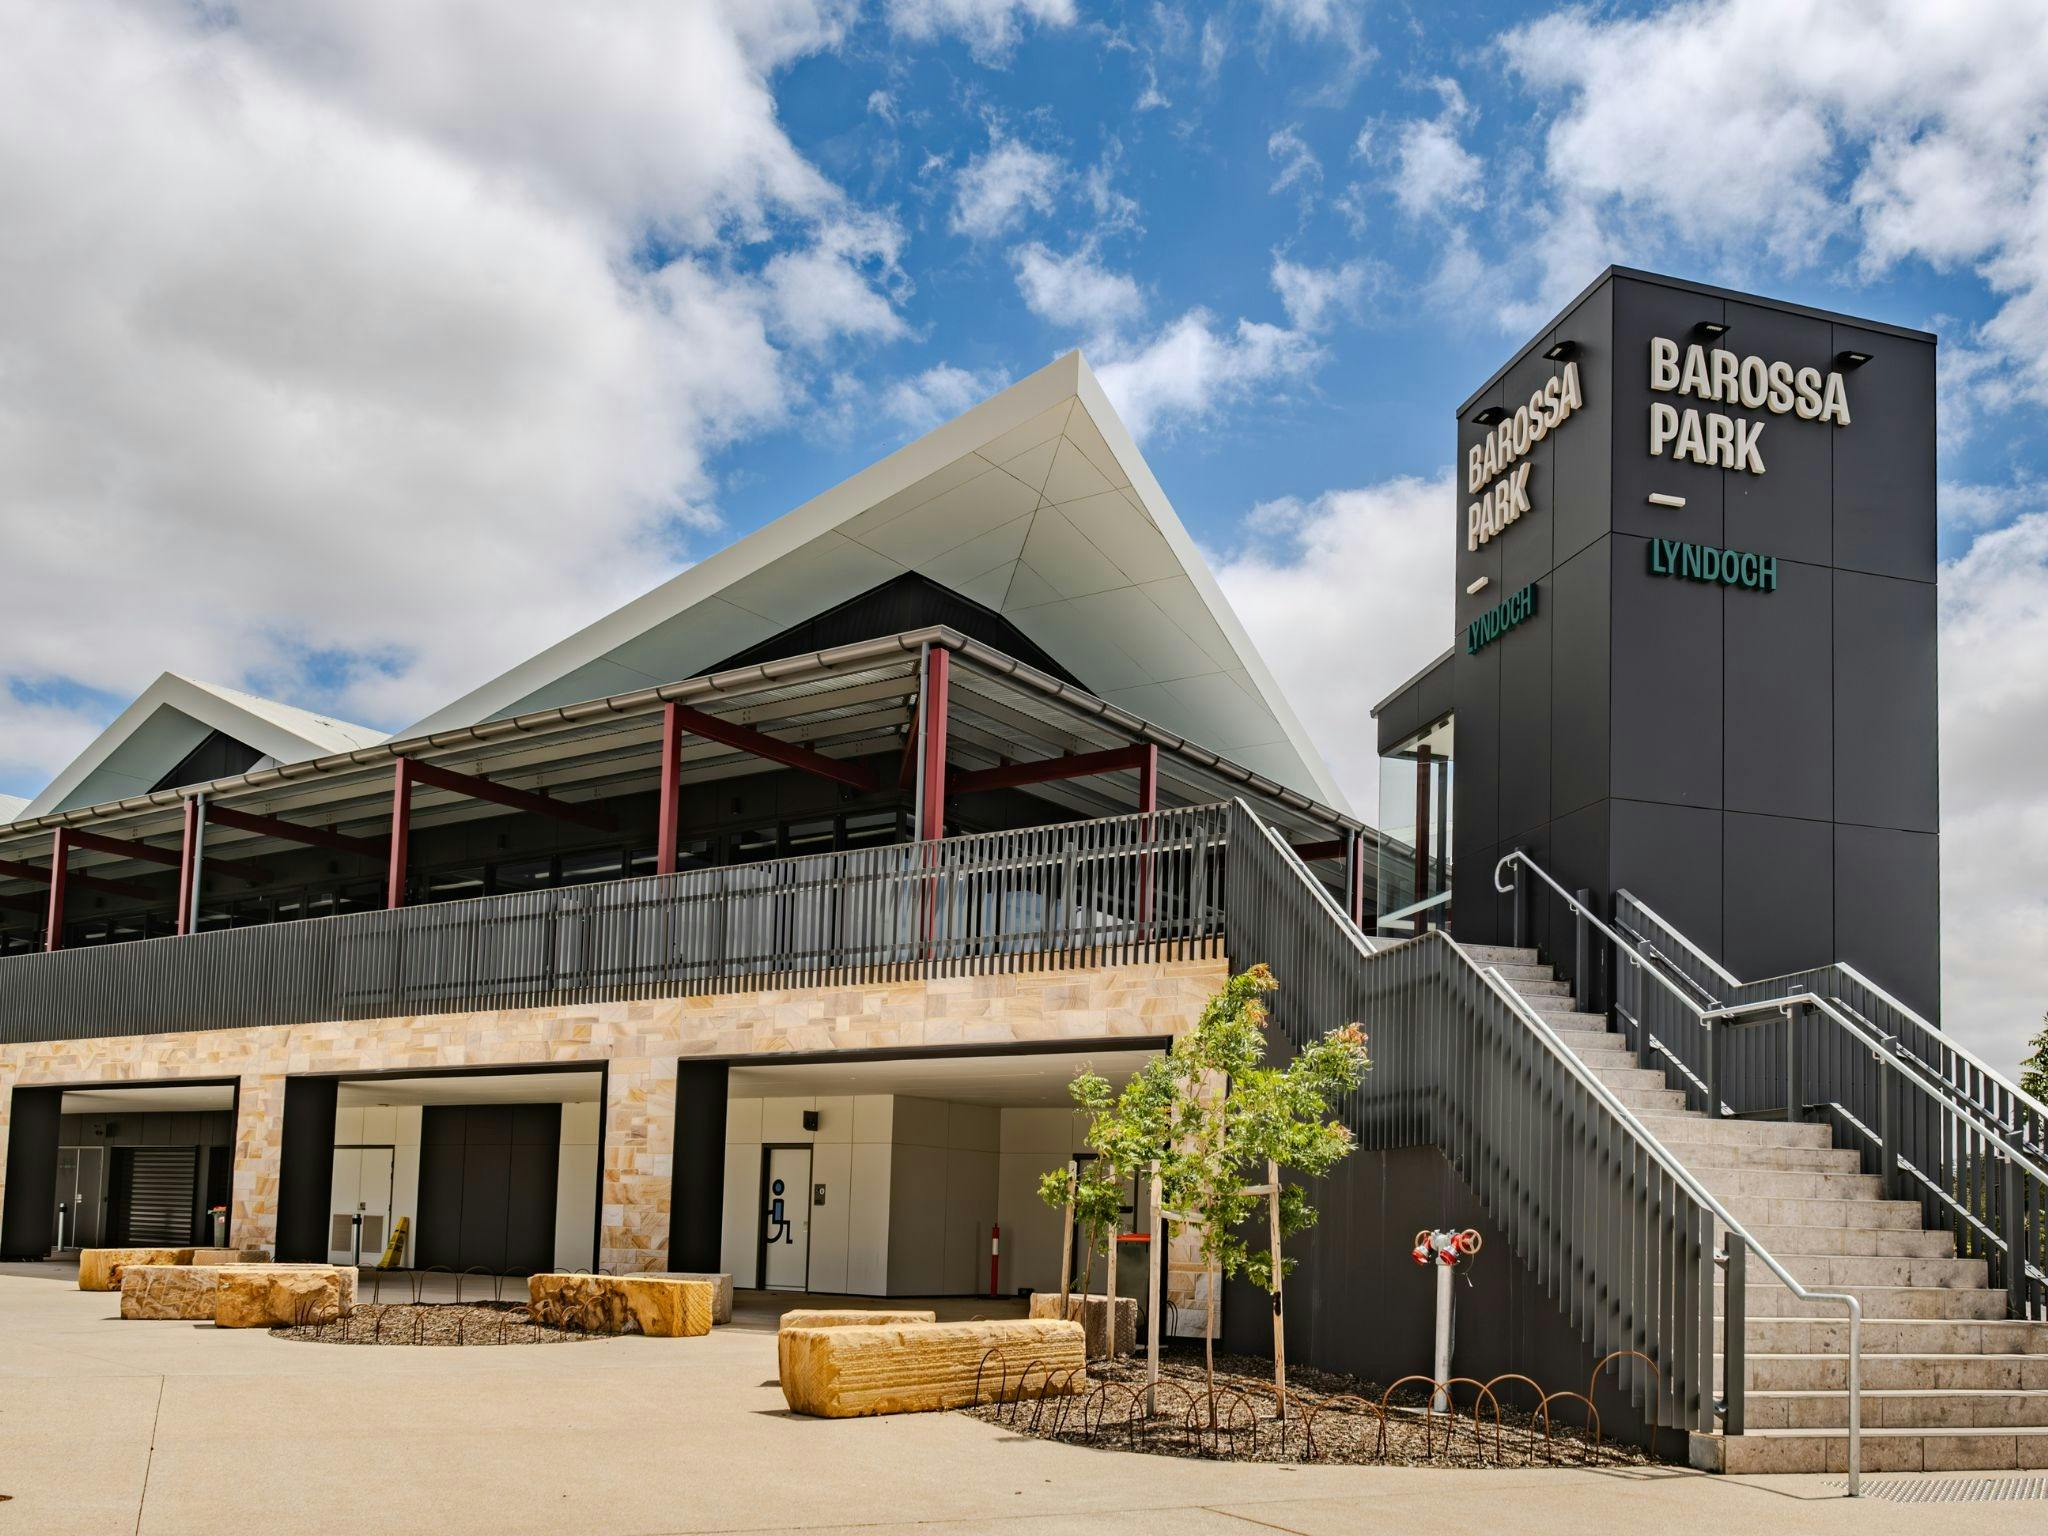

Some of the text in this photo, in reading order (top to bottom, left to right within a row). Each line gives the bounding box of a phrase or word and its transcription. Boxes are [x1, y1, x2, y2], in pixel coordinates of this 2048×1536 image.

[1651, 336, 1851, 426] BAROSSA
[1469, 361, 1583, 495] BAROSSA
[1650, 402, 1766, 475] PARK
[1468, 462, 1531, 552] PARK
[1649, 537, 1777, 592] LYNDOCH
[1466, 583, 1537, 655] LYNDOCH
